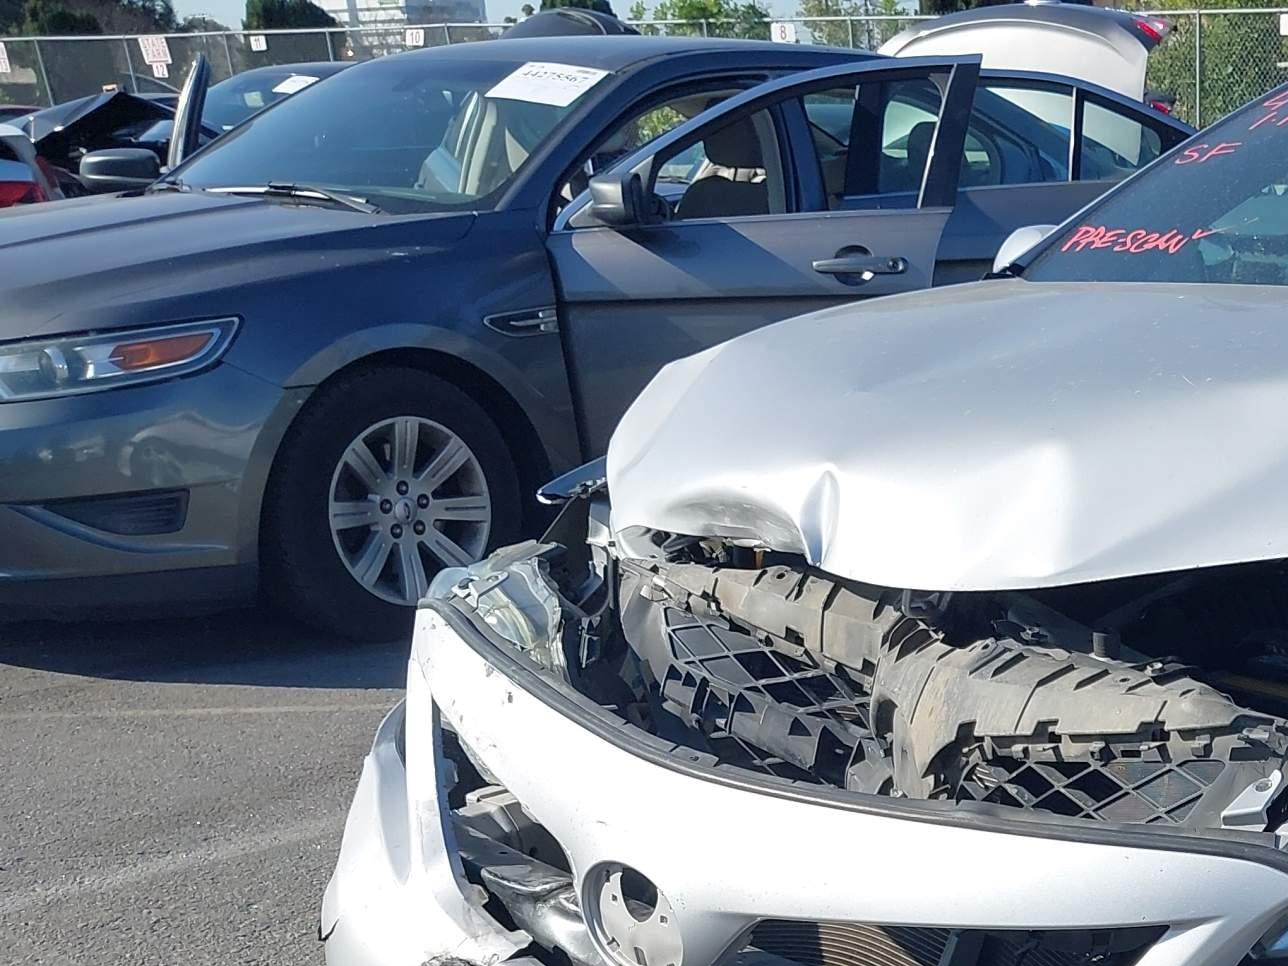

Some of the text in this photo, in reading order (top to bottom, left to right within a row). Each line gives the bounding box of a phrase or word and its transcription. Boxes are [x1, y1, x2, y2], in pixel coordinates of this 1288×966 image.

[410, 31, 421, 44] 10
[780, 25, 787, 40] 8
[253, 38, 262, 49] 11
[155, 64, 166, 76] 12
[1174, 142, 1242, 164] SF
